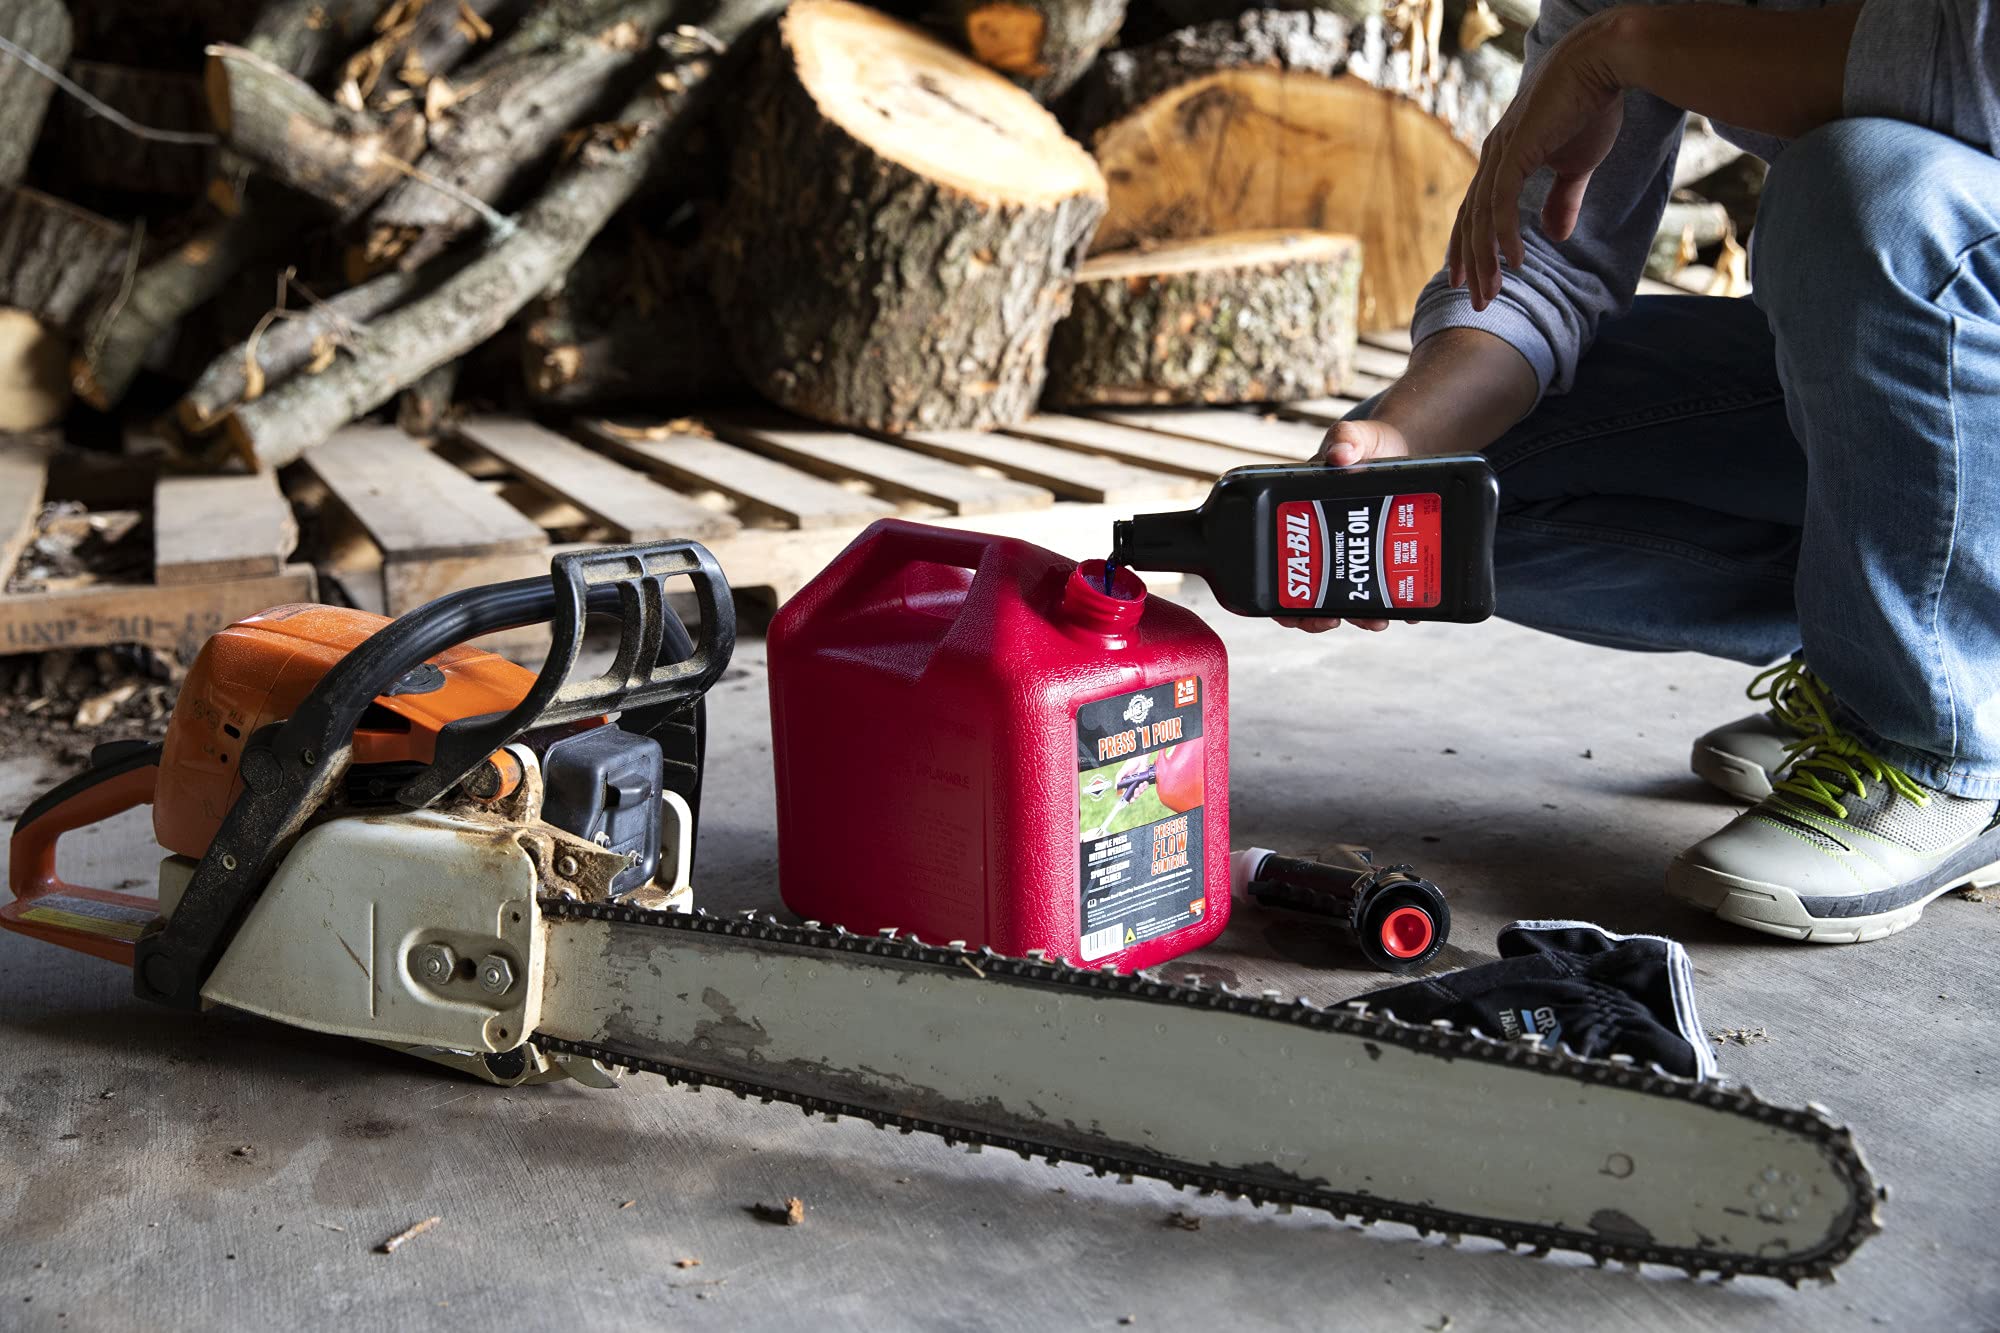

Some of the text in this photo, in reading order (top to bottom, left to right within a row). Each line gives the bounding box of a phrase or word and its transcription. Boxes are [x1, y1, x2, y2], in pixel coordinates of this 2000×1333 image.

[1398, 505, 1406, 522] GALLON
[1406, 503, 1414, 528] MULTI-MIX
[1286, 512, 1311, 600] STA-BIL
[1335, 531, 1344, 579] FULL SYNTHETIC
[1348, 507, 1370, 600] 2-CYCLE OIL
[1394, 541, 1402, 565] STABILIZES
[1401, 542, 1410, 563] FUEL FOR
[1410, 540, 1418, 559] MONTHS
[1398, 579, 1407, 599] ETHANOL
[1406, 575, 1415, 602] PROTECTION
[1098, 729, 1136, 761] PRESS
[1152, 717, 1183, 745] POUR
[1153, 815, 1188, 841] PRECISE
[1152, 831, 1188, 861] FLOW
[1151, 851, 1189, 876] CONTROL
[1534, 1006, 1557, 1034] GR
